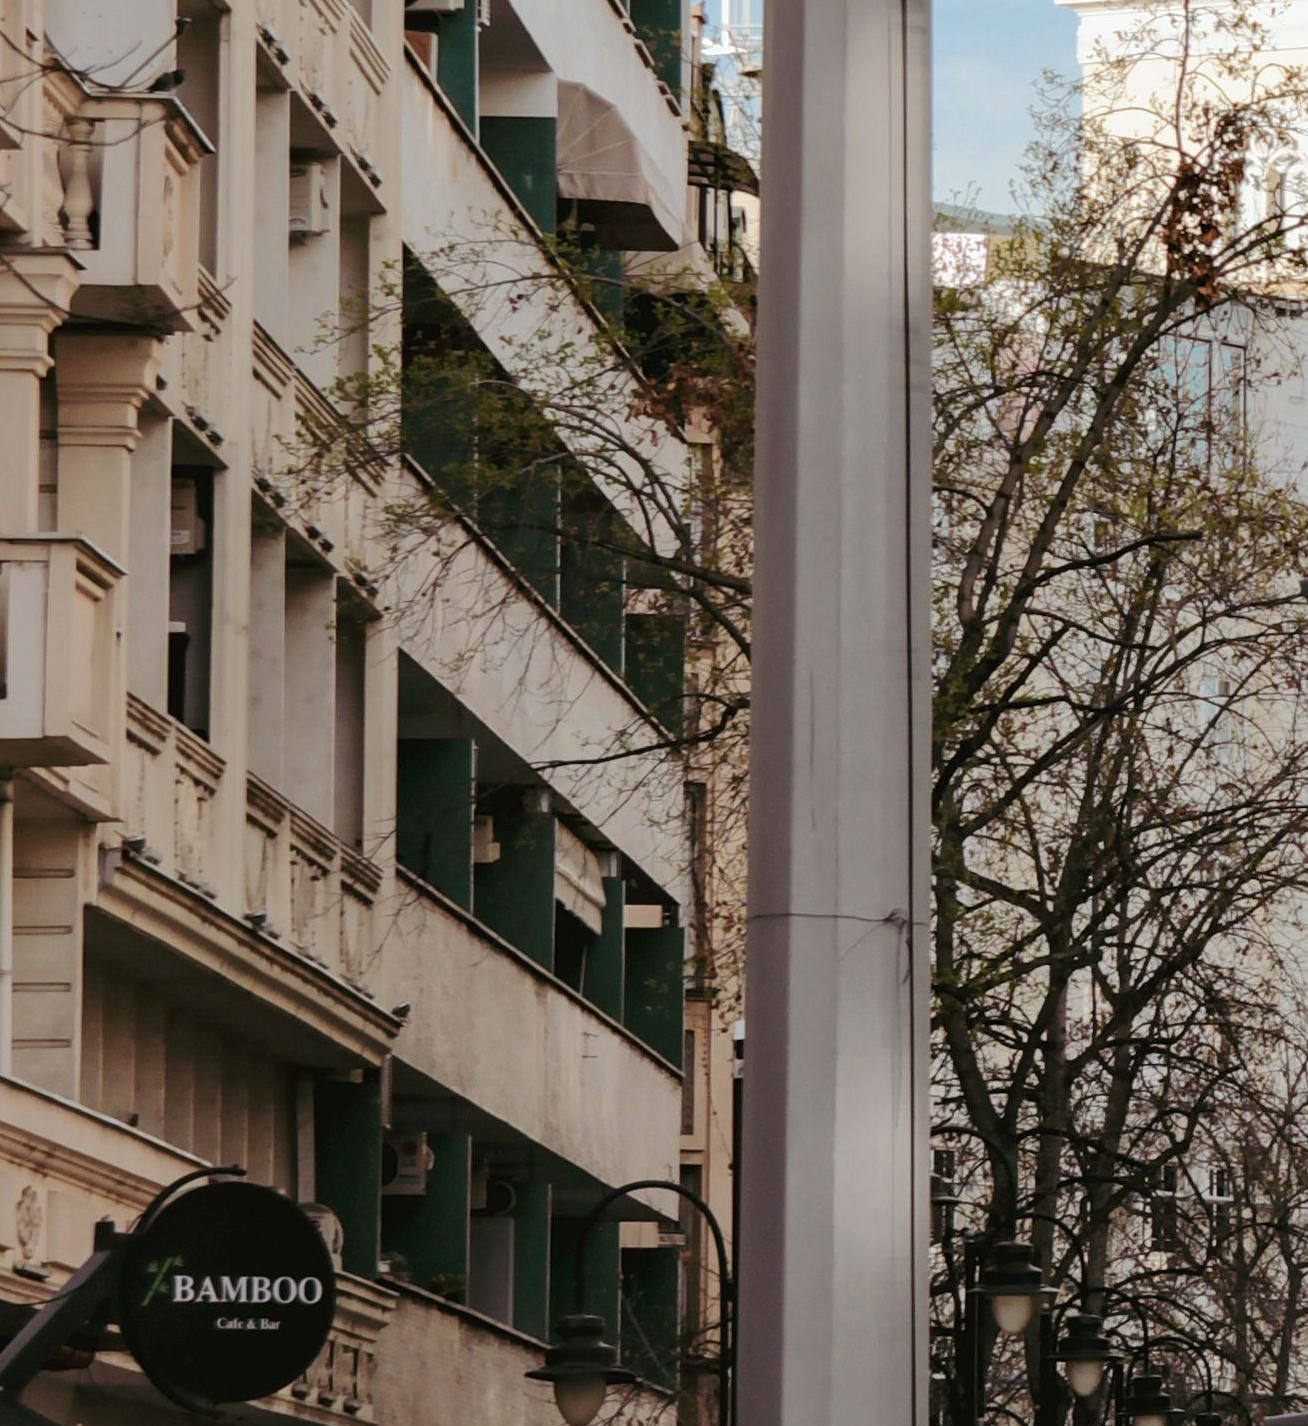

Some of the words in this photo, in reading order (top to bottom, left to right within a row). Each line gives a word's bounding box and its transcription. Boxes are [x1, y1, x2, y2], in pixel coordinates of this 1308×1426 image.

[172, 1274, 323, 1304] BAMBOO
[216, 1317, 243, 1329] Cafe
[246, 1319, 256, 1329] &
[260, 1318, 281, 1330] Bar
